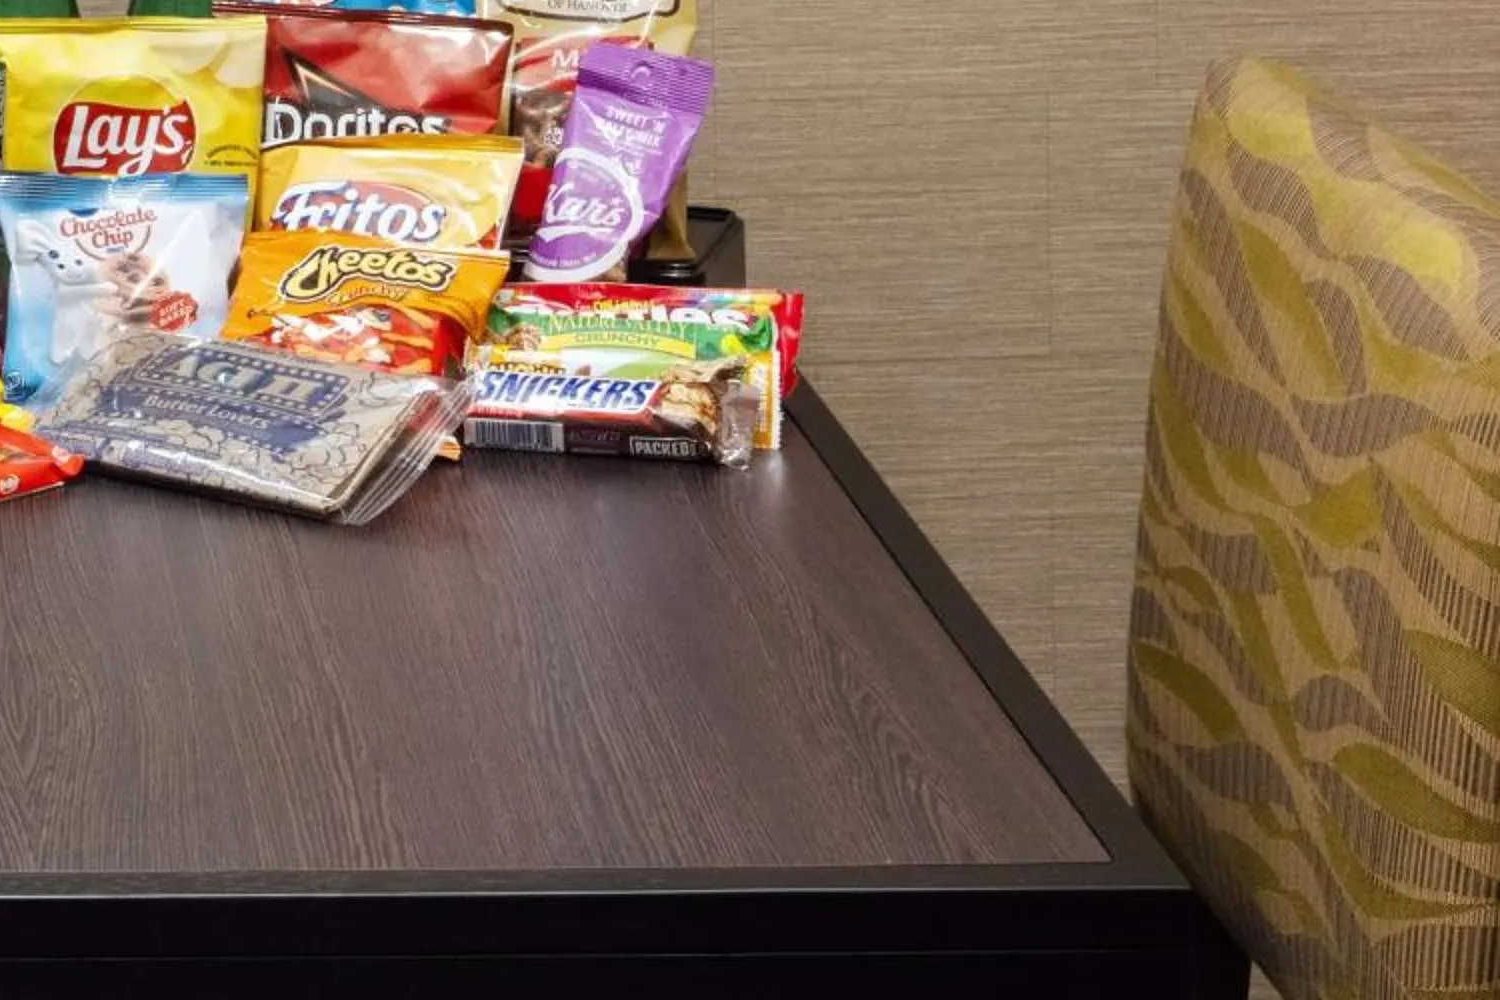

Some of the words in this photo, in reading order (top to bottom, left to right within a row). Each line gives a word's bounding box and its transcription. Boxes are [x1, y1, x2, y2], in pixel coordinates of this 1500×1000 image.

[62, 103, 189, 176] Lay's
[262, 98, 446, 147] Doritos
[60, 206, 157, 237] Chocolate
[271, 181, 446, 241] Fritos
[92, 228, 134, 248] Chip
[284, 247, 450, 298] Cheetos
[548, 312, 619, 332] NATURE
[574, 330, 662, 347] CRUNCHY
[478, 371, 654, 411] SNICKERS
[143, 395, 202, 417] Butter
[207, 406, 270, 431] Lovers
[633, 438, 690, 457] PACKED
